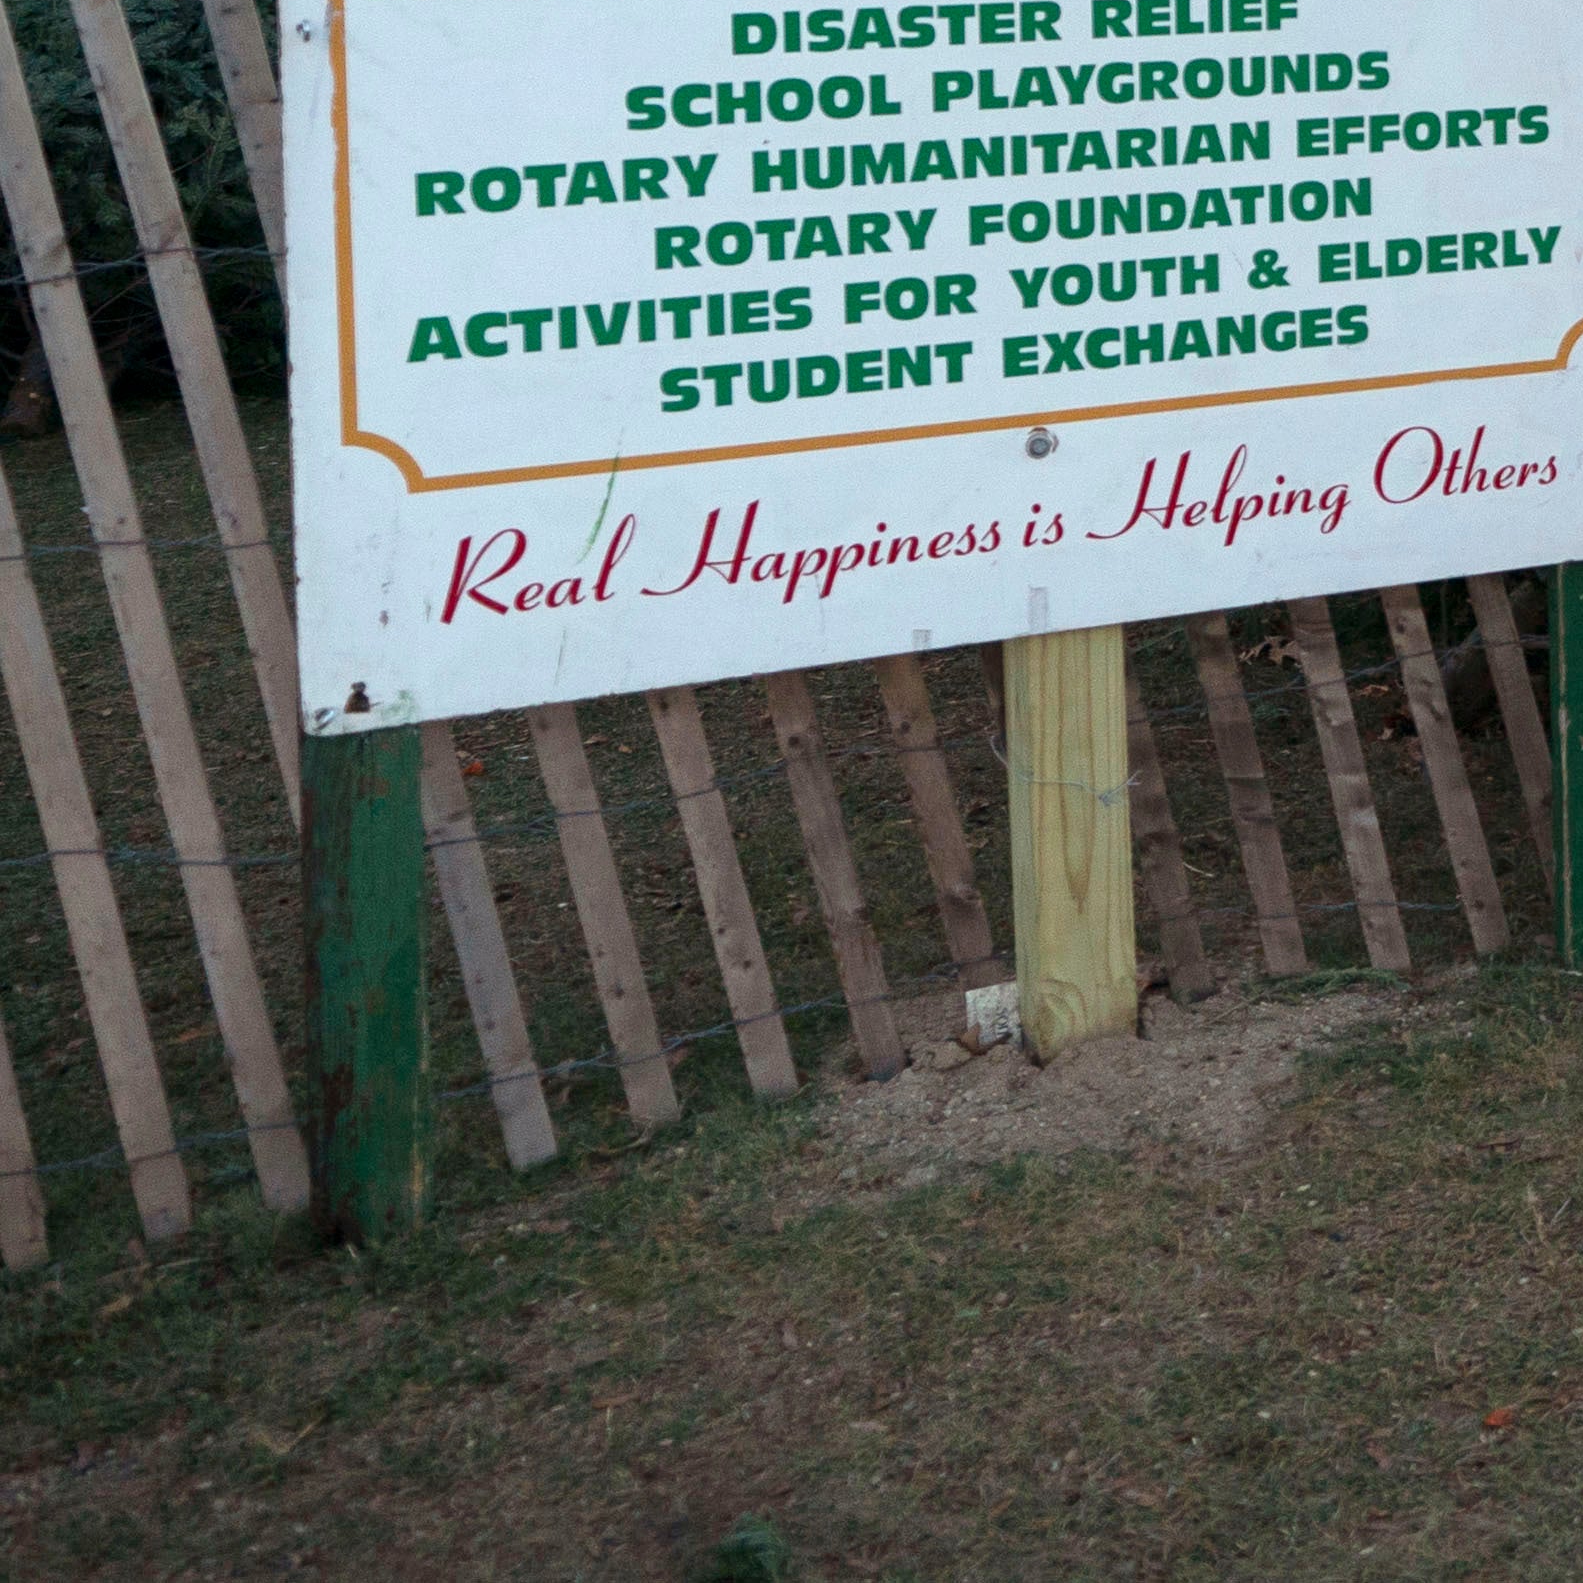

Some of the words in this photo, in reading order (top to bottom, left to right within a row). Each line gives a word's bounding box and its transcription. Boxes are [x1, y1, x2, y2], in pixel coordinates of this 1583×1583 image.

[730, 0, 1062, 56] DISASTER
[625, 72, 902, 131] SCHOOL
[933, 48, 1391, 113] PLAYGROUNDS
[414, 151, 719, 217] ROTARY
[751, 119, 1272, 194] HUMANITARIAN
[1296, 104, 1550, 158] EFFORTS
[654, 206, 938, 271] ROTARY
[967, 175, 1374, 247] FOUNDATION
[407, 284, 814, 364] ACTIVITIES
[843, 272, 978, 324] FOR
[1010, 252, 1222, 310] YOUTH
[1247, 247, 1289, 291] &
[1318, 223, 1561, 283] ELDERLY
[659, 339, 975, 414] STUDENT
[1001, 303, 1370, 379] EXCHANGES
[440, 513, 636, 624] Real
[640, 499, 1001, 604] Happiness
[1022, 504, 1065, 547] is
[1085, 444, 1351, 547] Helping
[1373, 425, 1558, 504] Others
